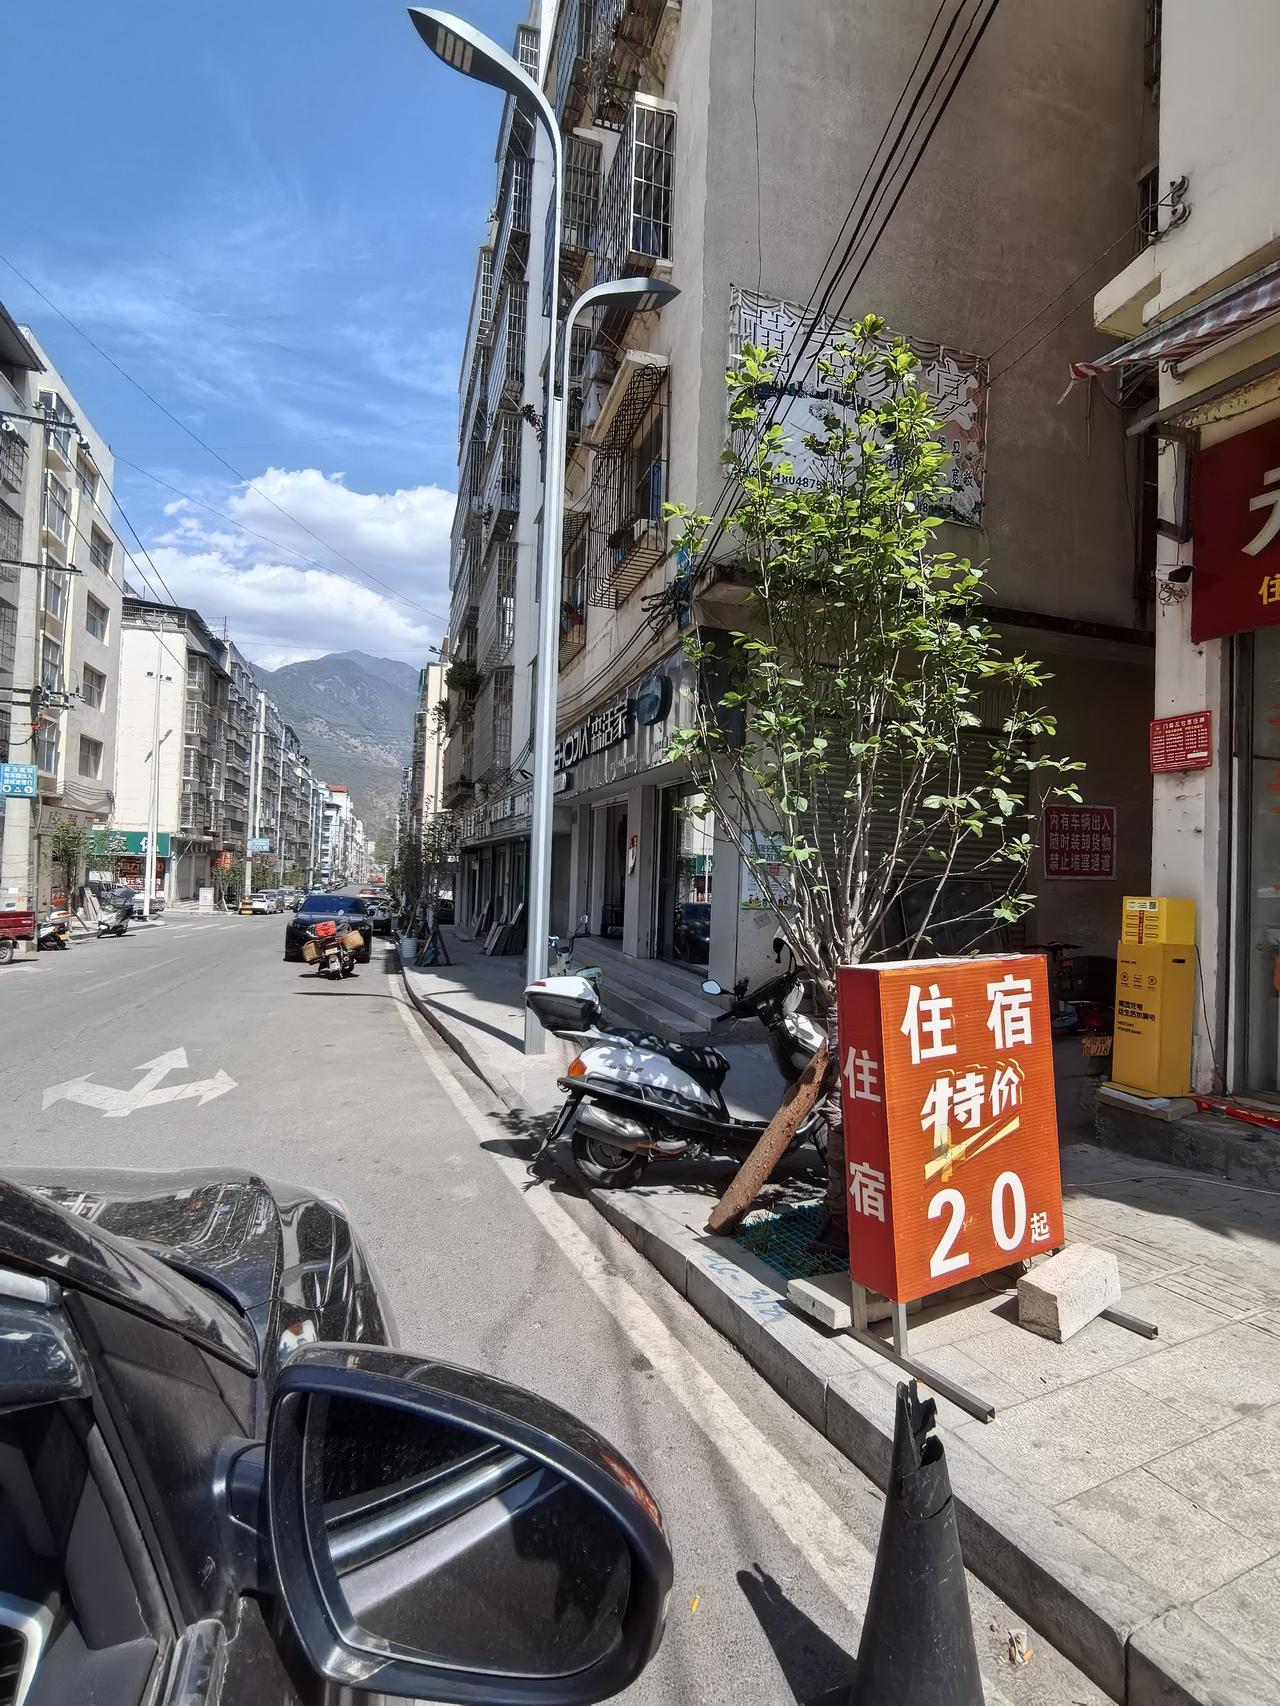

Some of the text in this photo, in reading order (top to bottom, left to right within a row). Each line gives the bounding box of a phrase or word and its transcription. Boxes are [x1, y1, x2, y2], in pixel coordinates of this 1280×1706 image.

[1049, 832, 1111, 851] 随时装卸货物
[1050, 812, 1111, 831] 内有车辆出入
[1049, 852, 1111, 872] 禁止堵塞通道
[900, 974, 1034, 1065] 住宿
[843, 1045, 886, 1223] 住宿
[920, 1066, 1020, 1150] 特价
